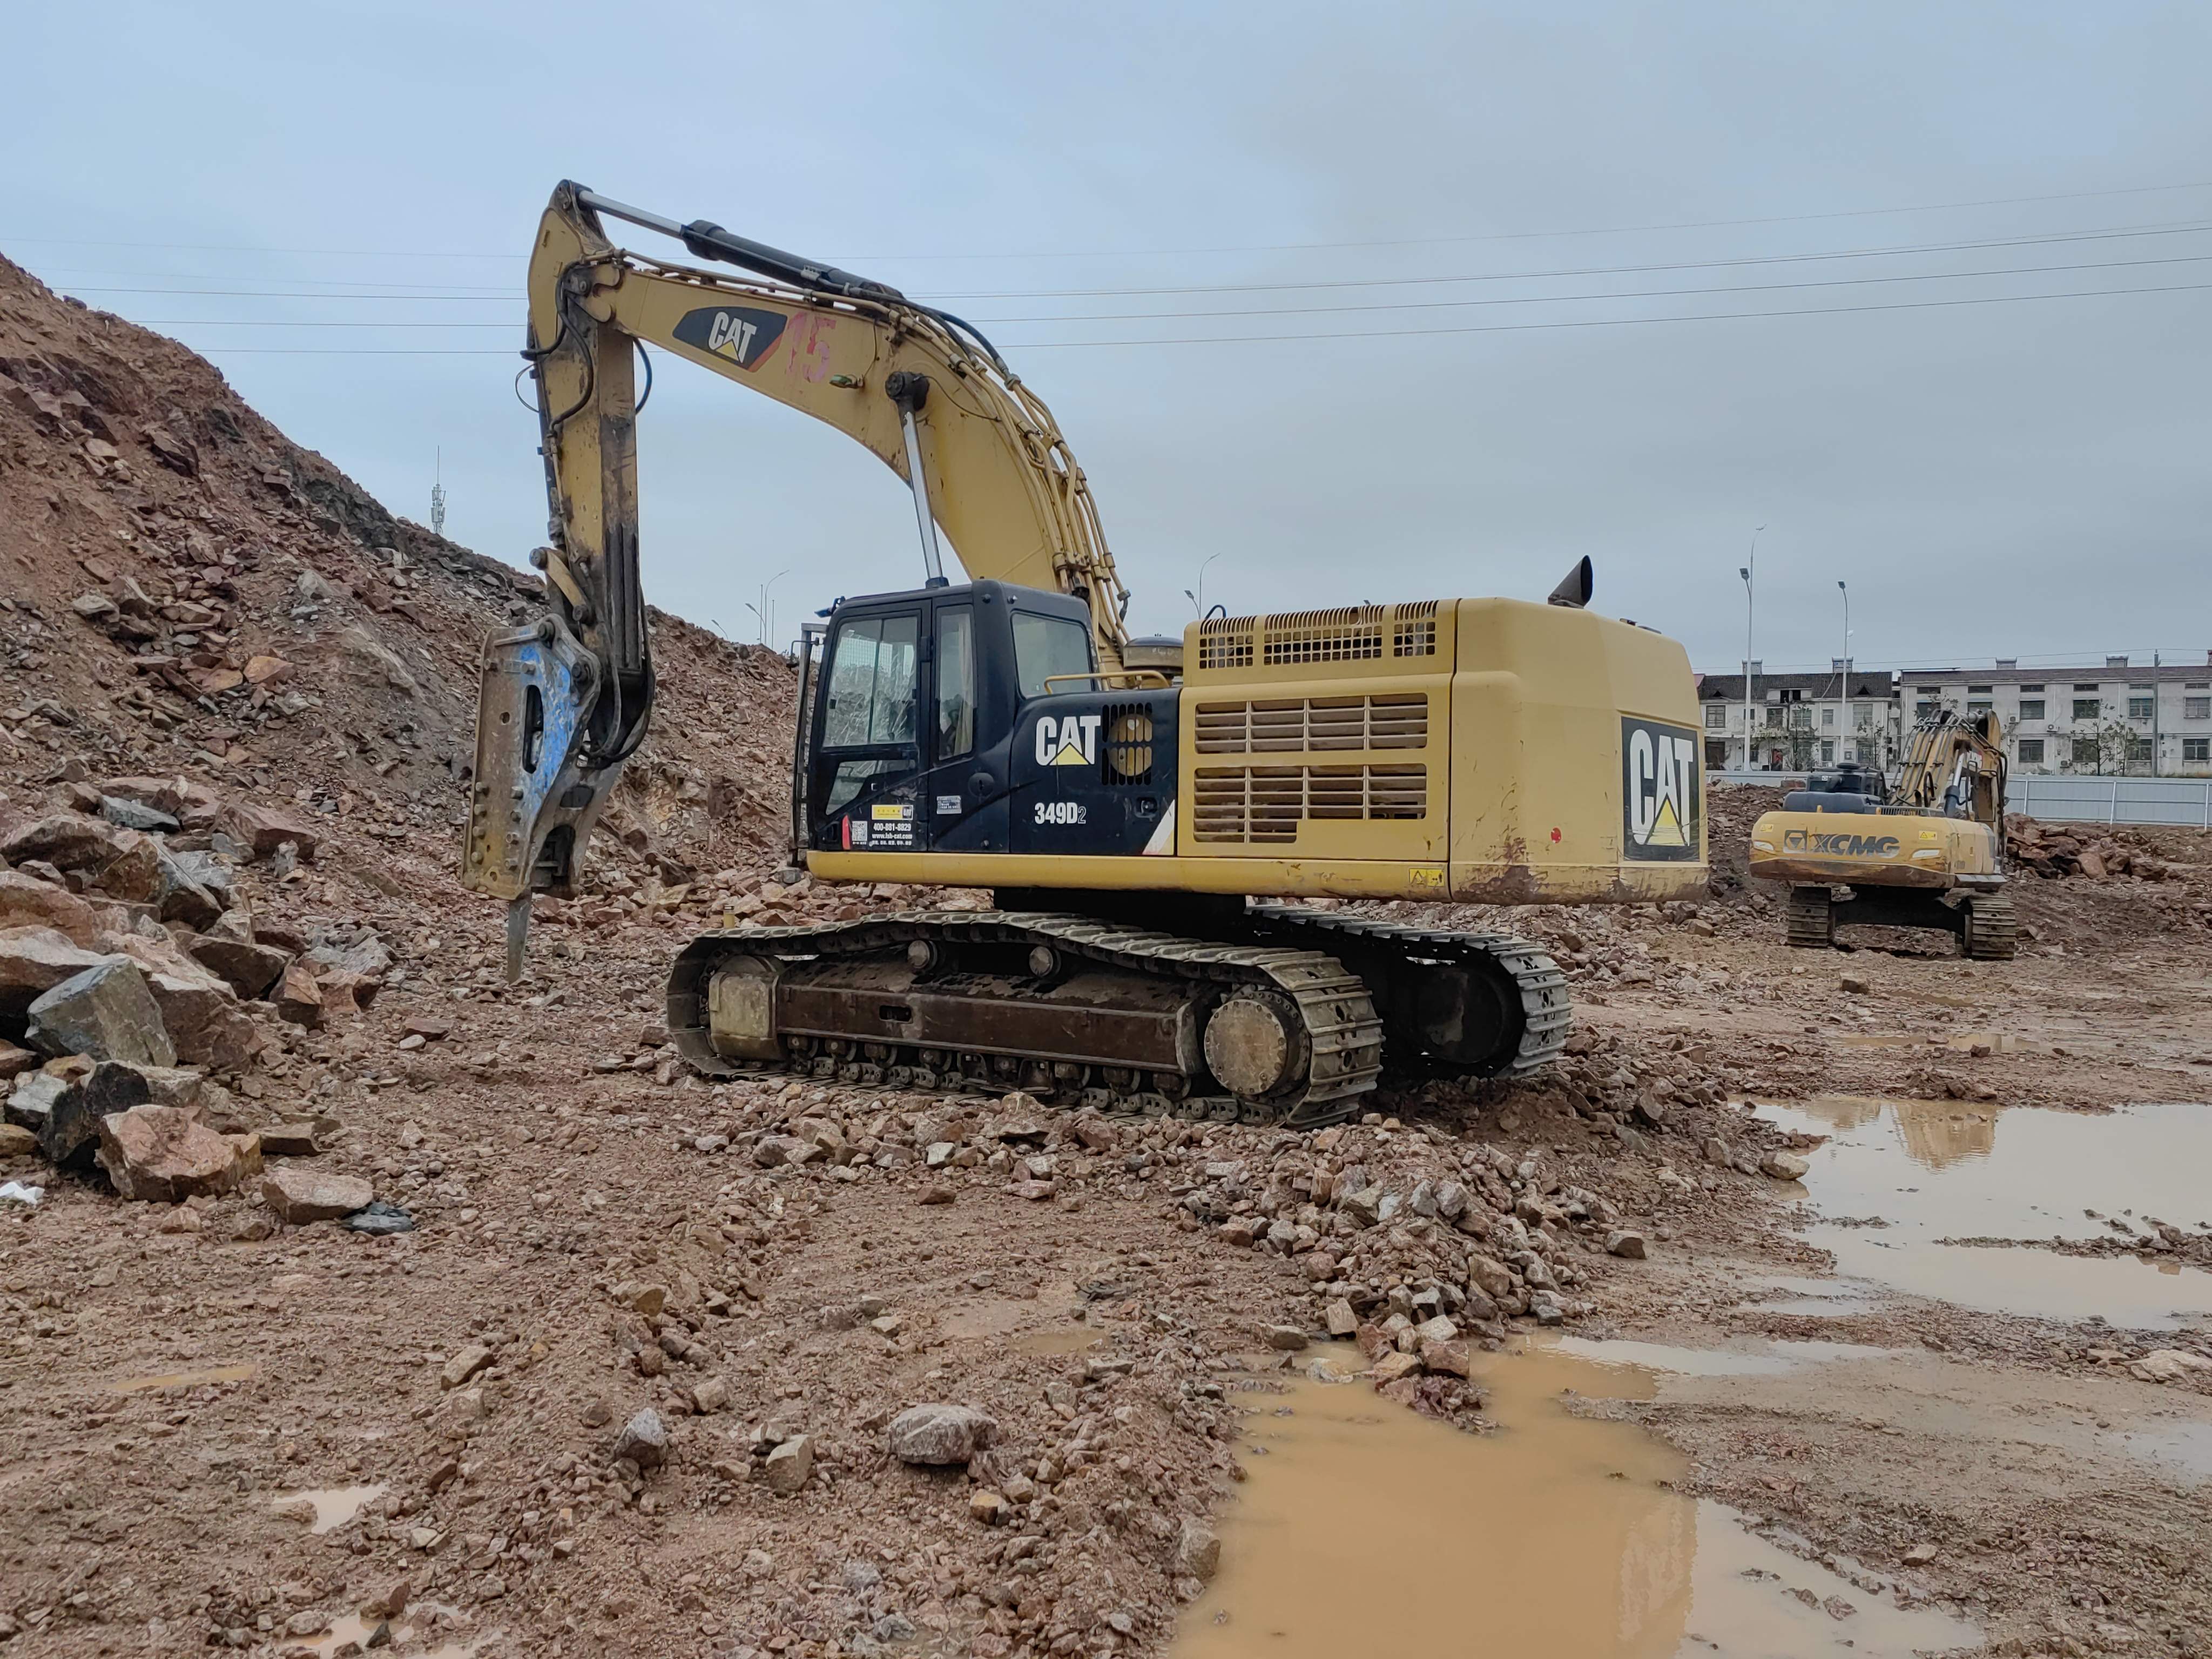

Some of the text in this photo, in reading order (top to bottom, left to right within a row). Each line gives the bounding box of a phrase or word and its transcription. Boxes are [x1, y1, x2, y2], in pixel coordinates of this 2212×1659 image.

[708, 311, 757, 363] CAT
[1036, 715, 1101, 765] CAT
[1630, 729, 1694, 846] CAT
[1034, 802, 1087, 825] 349D2
[1810, 834, 1900, 859] XCMG
